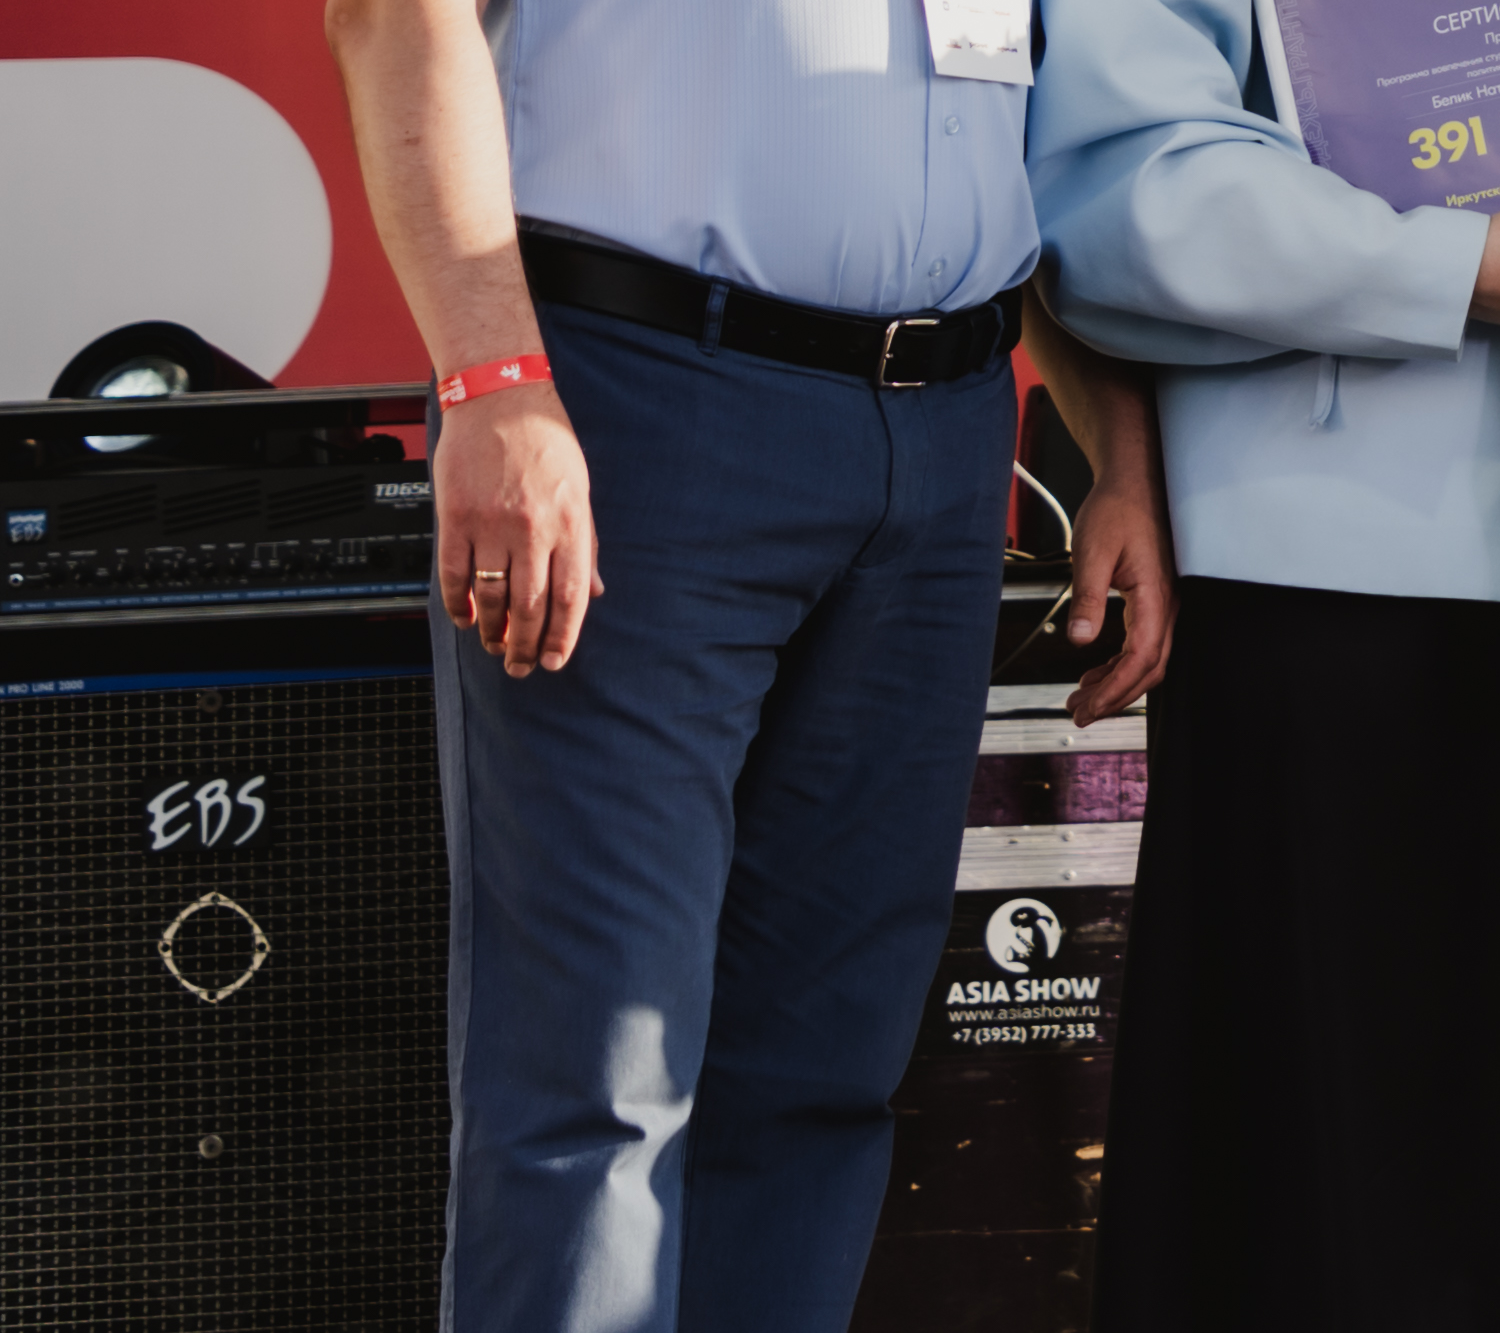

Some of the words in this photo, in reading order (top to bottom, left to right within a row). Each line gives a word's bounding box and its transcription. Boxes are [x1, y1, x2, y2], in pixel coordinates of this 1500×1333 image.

[1431, 91, 1474, 109] Белик
[1408, 115, 1488, 170] 391
[147, 775, 266, 850] EBS
[946, 982, 1011, 1004] ASIA
[1014, 977, 1100, 1002] SHOW
[948, 1004, 1100, 1022] www.asiashow.ru
[952, 1027, 971, 1043] +7
[974, 1025, 1027, 1045] (3952)
[1030, 1023, 1096, 1040] 777-333
